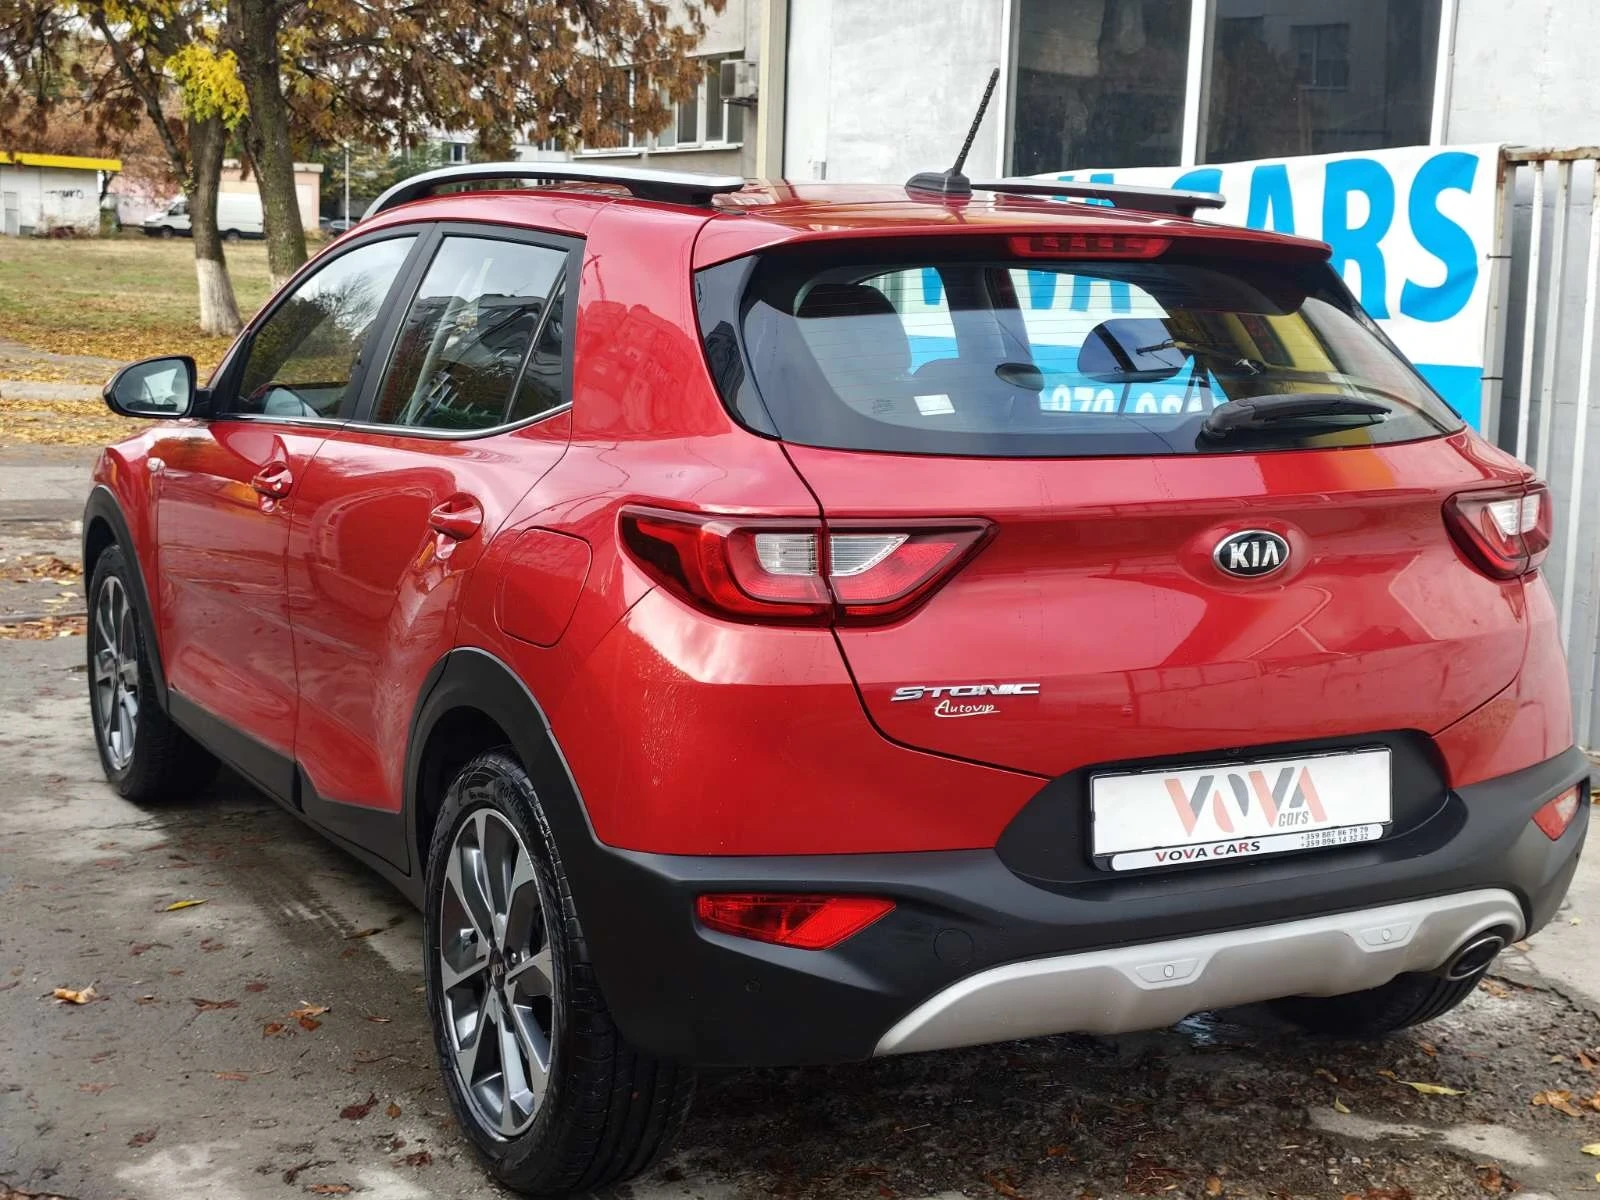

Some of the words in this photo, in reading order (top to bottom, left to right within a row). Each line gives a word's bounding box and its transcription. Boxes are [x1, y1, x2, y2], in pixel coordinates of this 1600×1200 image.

[1229, 540, 1280, 568] KIA
[891, 683, 1040, 701] STONIC
[934, 700, 1000, 718] Autovip
[1164, 766, 1328, 837] VOVA
[1155, 847, 1208, 862] VOVA
[1213, 841, 1261, 856] CARS
